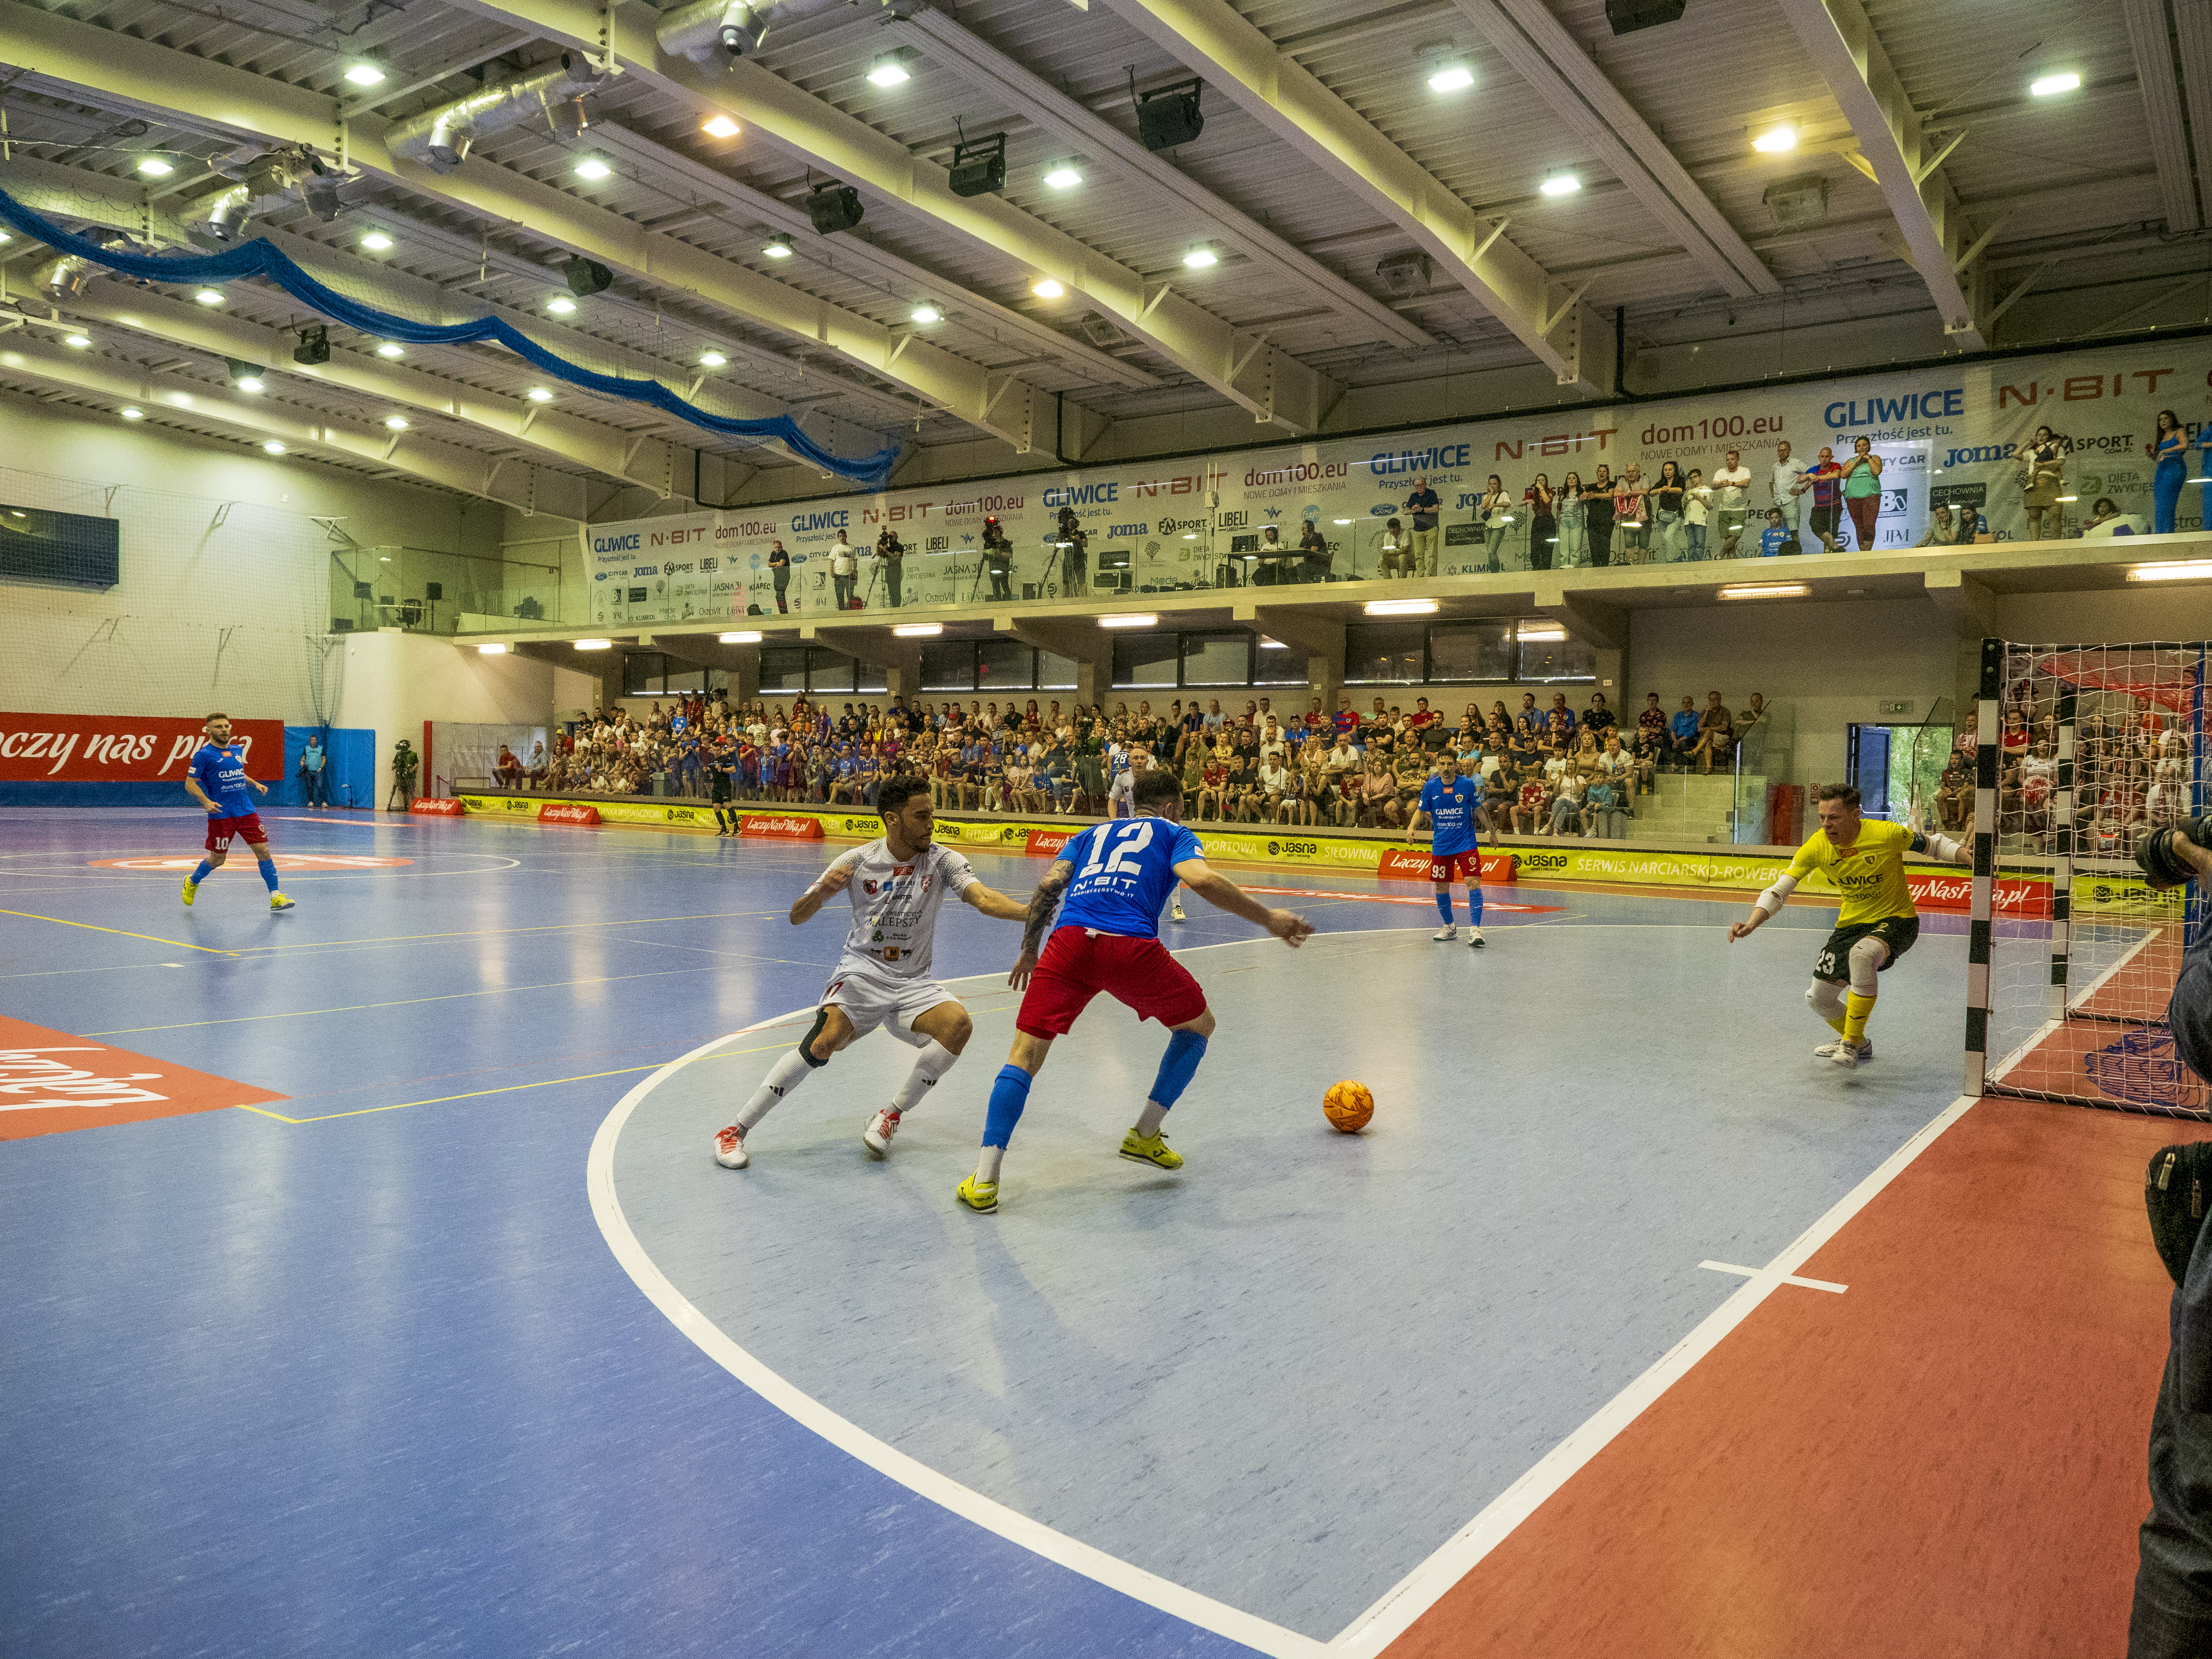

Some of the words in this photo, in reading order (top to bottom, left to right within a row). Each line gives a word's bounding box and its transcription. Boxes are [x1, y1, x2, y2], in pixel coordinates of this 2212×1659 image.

[1825, 389, 1964, 428] GLIWICE
[1641, 415, 1783, 445] dom100.eu
[1906, 426, 1932, 440] jest
[1936, 425, 1953, 434] tu.
[1641, 448, 1672, 460] NOWE
[1676, 445, 1707, 456] DOMY
[1716, 438, 1781, 453] MIESZKANIA
[1371, 443, 1470, 475] GLIWICE
[1899, 455, 1925, 465] CAR
[1244, 463, 1347, 486] dom100.eu
[1430, 474, 1447, 486] jest
[2109, 473, 2139, 483] DIETA
[1042, 482, 1118, 507] GLIWICE
[1244, 490, 1266, 499] NOWE
[1269, 486, 1291, 497] DOMY
[1298, 482, 1346, 493] MIESZKANIA
[946, 495, 1024, 515] dom100.eu
[792, 510, 849, 532] GLIWICE
[964, 517, 982, 525] DOMY
[1219, 511, 1248, 527] LIBELI
[716, 521, 776, 539] dom100.eu
[594, 534, 640, 553] GLIWICE
[797, 534, 824, 544] Przyszłość
[825, 533, 836, 541] jest
[926, 536, 948, 550] LIBELI
[700, 558, 718, 570] LIBELI
[943, 565, 970, 575] JASNA
[713, 582, 734, 591] JASNA
[926, 592, 955, 602] OstroVit
[83, 734, 157, 764] nas
[219, 768, 244, 777] GLIWIC
[598, 807, 617, 815] CIANKA
[619, 809, 663, 818] WSPINACZKOWA
[675, 810, 694, 819] Jasna
[699, 813, 718, 823] SQUAS
[820, 820, 840, 829] BASEN
[855, 820, 879, 829] Jasna
[935, 824, 960, 835] Jasna
[966, 829, 998, 839] FITNESS
[215, 837, 229, 850] 10
[1282, 842, 1316, 854] Jasna
[1079, 821, 1153, 879] 12
[1324, 846, 1377, 860] SIŁOWNIA
[1524, 855, 1567, 867] Jasna
[1577, 859, 1625, 872] SERWIS
[1432, 865, 1445, 879] 93
[867, 915, 921, 927] MALEPSZY
